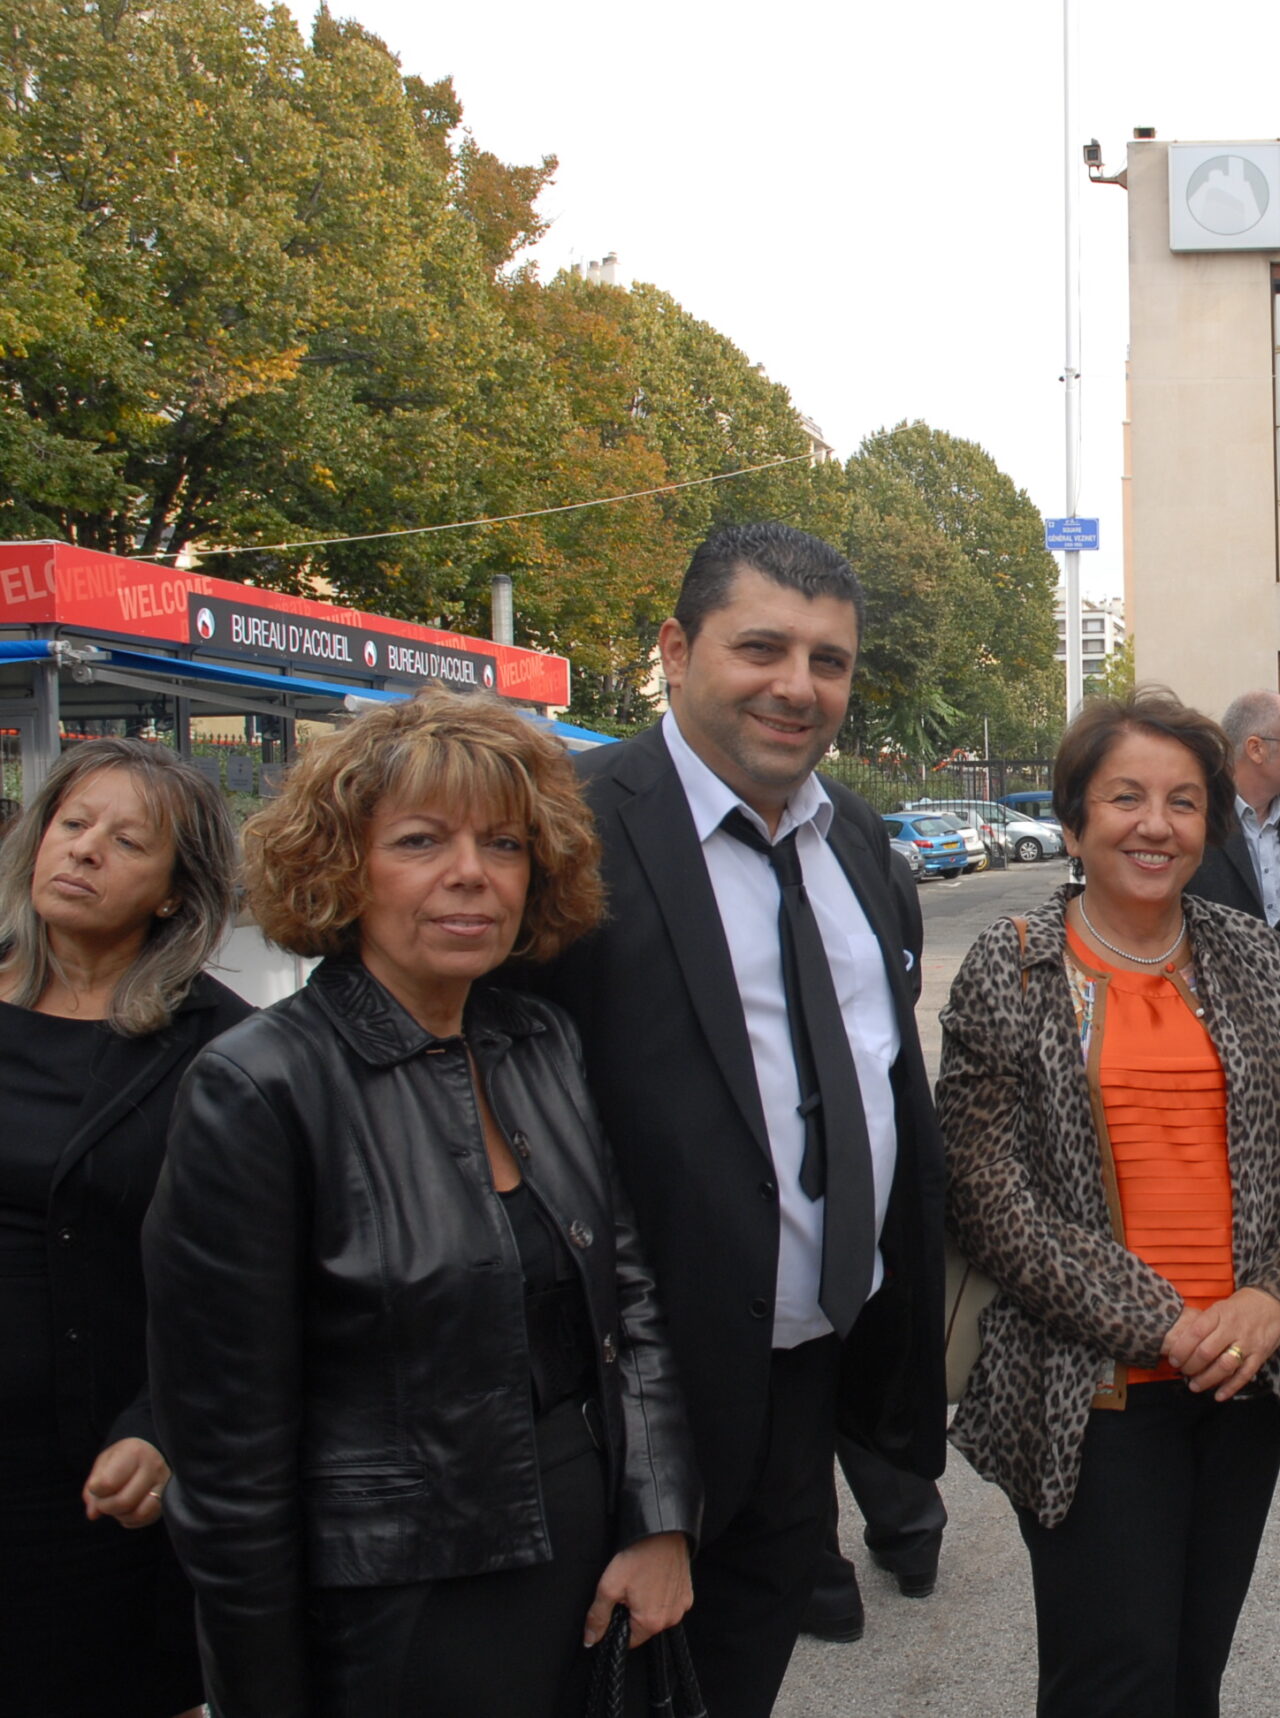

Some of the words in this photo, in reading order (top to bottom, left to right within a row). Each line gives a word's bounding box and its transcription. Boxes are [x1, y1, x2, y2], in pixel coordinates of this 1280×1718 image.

[232, 614, 286, 651] BUREAU
[289, 625, 353, 662] D'ACCUEIL
[388, 644, 428, 677] BUREAU
[430, 653, 478, 685] D'ACCUEIL
[500, 654, 545, 688] WELCOME
